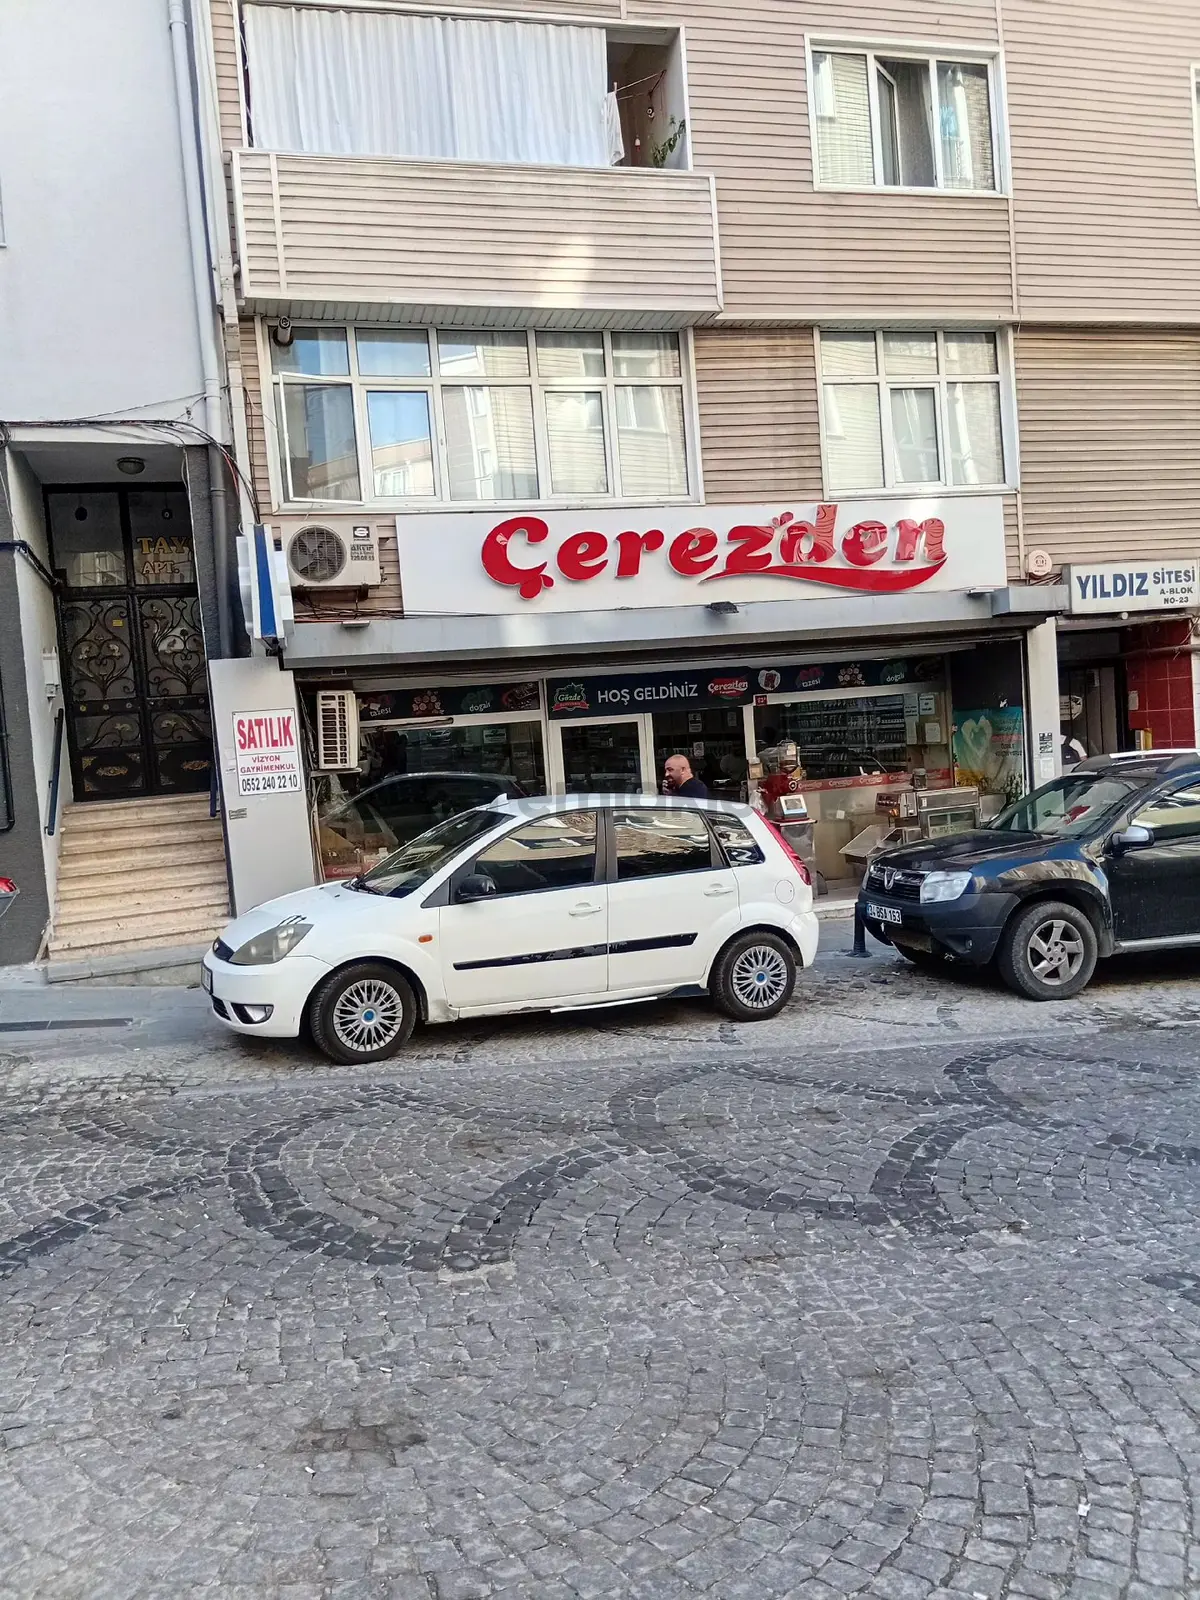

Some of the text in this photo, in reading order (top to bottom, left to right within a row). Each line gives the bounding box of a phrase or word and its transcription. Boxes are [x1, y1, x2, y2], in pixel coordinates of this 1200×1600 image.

[142, 561, 180, 574] APT.
[1076, 566, 1196, 599] YILDIZ SİTESİ
[1159, 586, 1194, 595] A-BLOK
[1163, 596, 1189, 604] NO-23
[598, 681, 698, 706] HOŞ GELDİNİZ
[237, 715, 295, 750] SATILIK
[251, 755, 281, 763] VİZYON
[240, 763, 296, 774] GAYRİMENKUL
[241, 774, 298, 792] 0552 240 22 10
